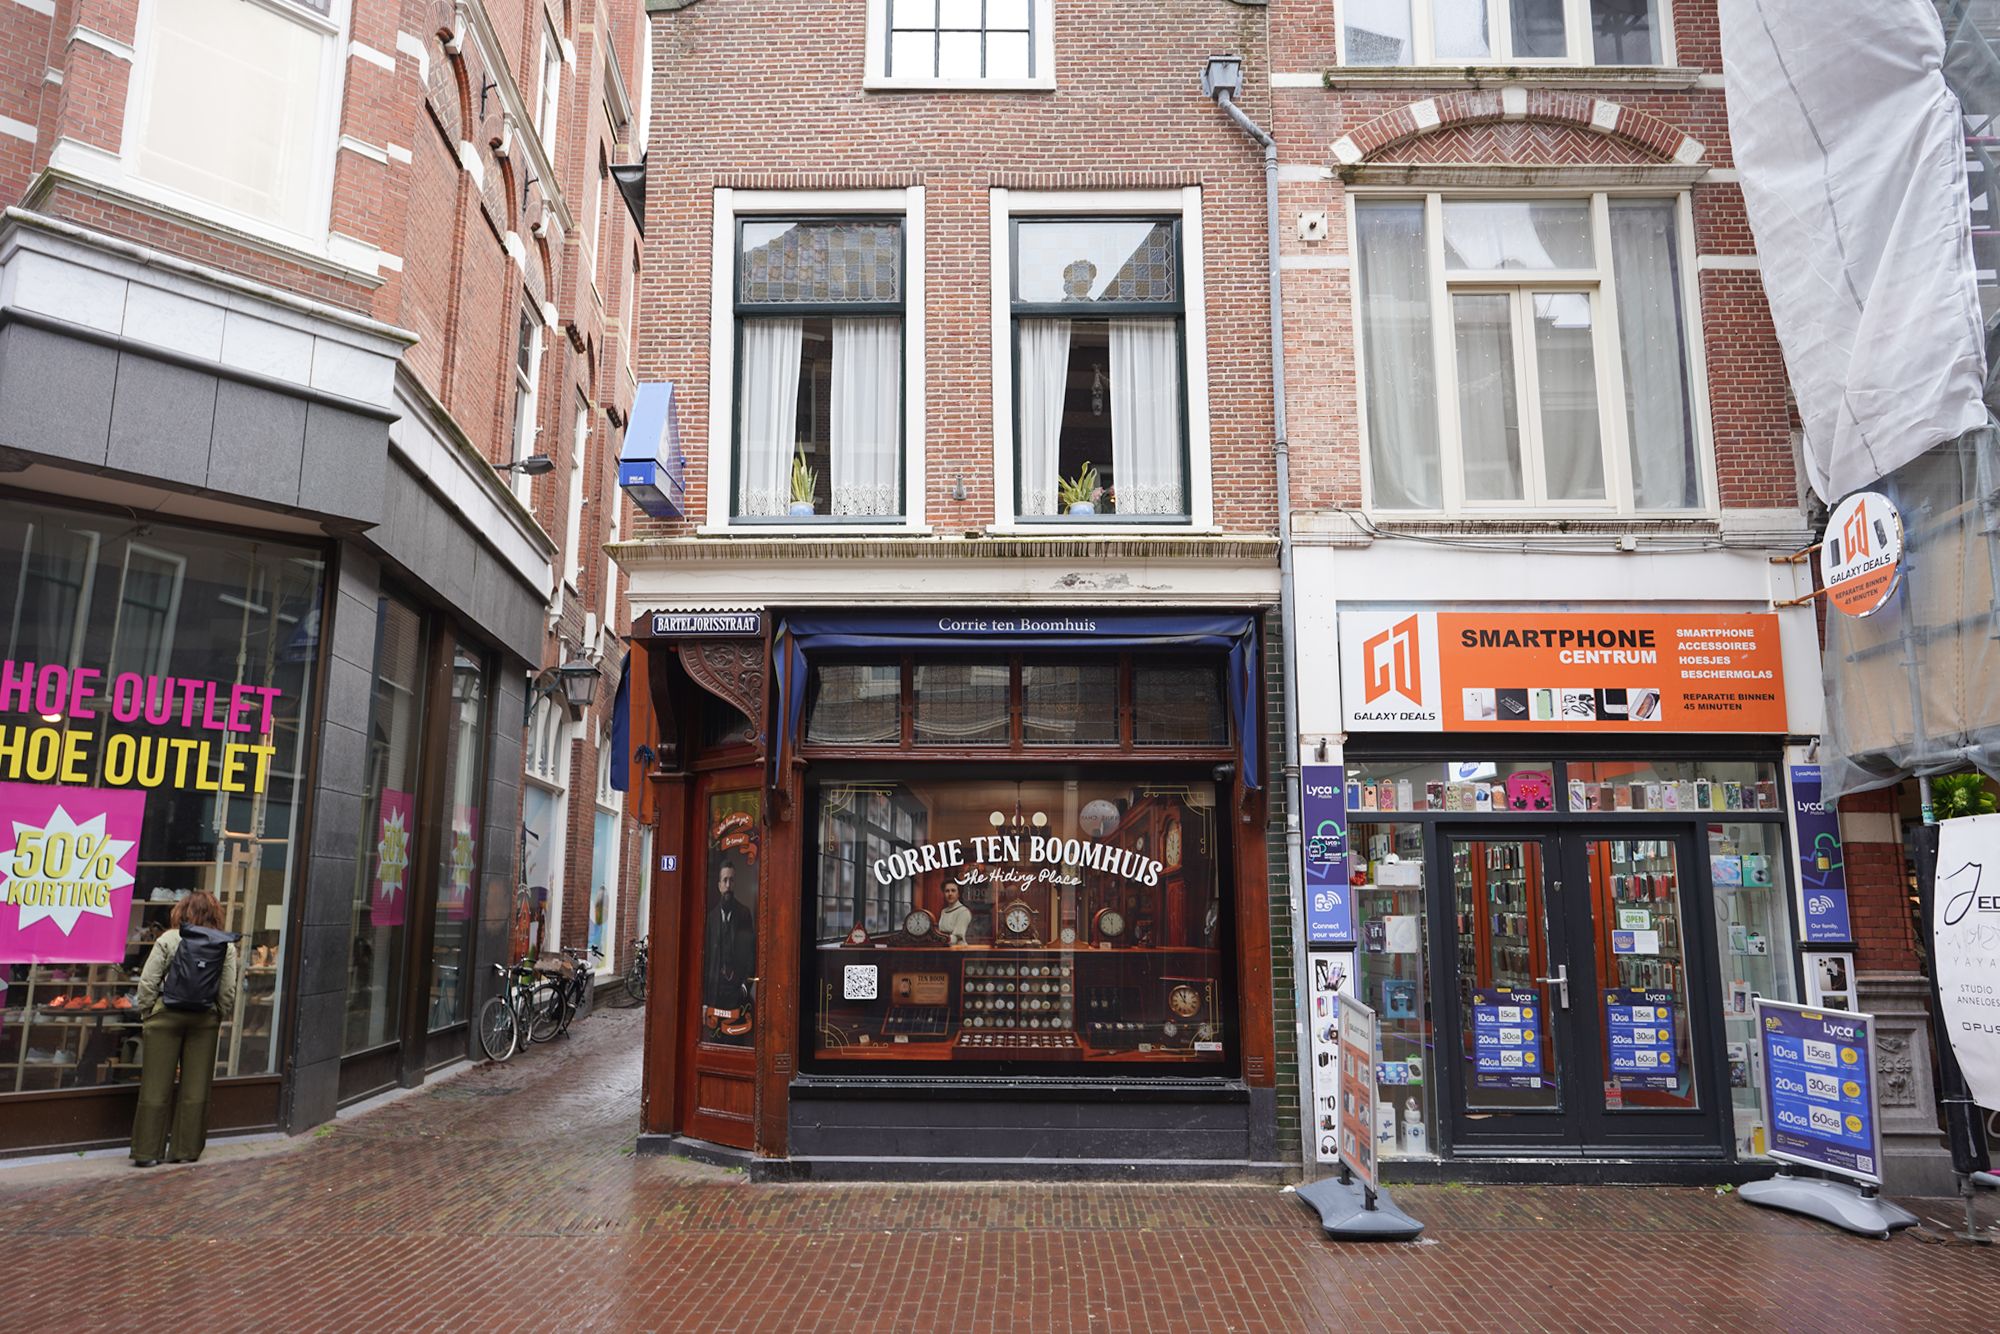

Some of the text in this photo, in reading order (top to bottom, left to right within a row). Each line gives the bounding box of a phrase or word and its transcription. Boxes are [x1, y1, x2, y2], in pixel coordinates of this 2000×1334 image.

[1831, 553, 1891, 584] GALAXY DEALS
[1835, 576, 1887, 599] REPARATIE BINNEN
[1853, 588, 1878, 602] MINUTEN
[657, 617, 755, 632] BARTELJORISSTRAAT
[939, 618, 1096, 631] Corrie ten Boomhuis
[1461, 629, 1655, 648] SMARTPHONE
[1676, 628, 1754, 638] SMARTPHONE
[1678, 642, 1757, 651] ACCESSOIRES
[1559, 649, 1657, 665] CENTRUM
[1679, 656, 1731, 665] HOESJES
[1681, 670, 1773, 679] BESCHERMGLAS
[0, 660, 281, 733] HOE OUTLET
[1683, 693, 1775, 701] REPARATIE BINNEN
[1683, 703, 1742, 711] 45 MINUTEN
[1354, 712, 1436, 721] GALAXY DEALS
[0, 725, 276, 793] HOE OUTLET
[1306, 785, 1332, 796] Lyca
[1797, 801, 1824, 812] Lyca
[12, 830, 115, 880] 50%
[663, 857, 675, 870] 19
[873, 836, 1164, 887] CORRIE TEN BOOMHUIS
[954, 868, 1081, 891] The Hiding Place
[7, 879, 111, 907] KORTING
[1625, 915, 1644, 923] OPEN
[1313, 932, 1327, 940] your
[1954, 957, 1996, 968] YAYA
[1961, 984, 1993, 994] STUDIO
[1511, 993, 1531, 1002] Lyca
[1645, 993, 1665, 1002] Lyca
[1957, 996, 2000, 1007] ANNELOES
[1477, 1010, 1517, 1022] 10GB 15GB
[1611, 1013, 1629, 1022] 10GB
[1823, 1021, 1854, 1037] Lyca
[1478, 1035, 1498, 1044] 20GB
[1612, 1032, 1654, 1044] 20GB 30GB
[1772, 1044, 1798, 1060] 10GB
[1807, 1045, 1831, 1059] 15GB
[1479, 1058, 1500, 1066] 40GB
[1614, 1058, 1635, 1066] 40GB
[1775, 1077, 1837, 1094] 20GB 30GB
[1778, 1110, 1808, 1126] 40GB
[1812, 1112, 1840, 1128] 60GB
